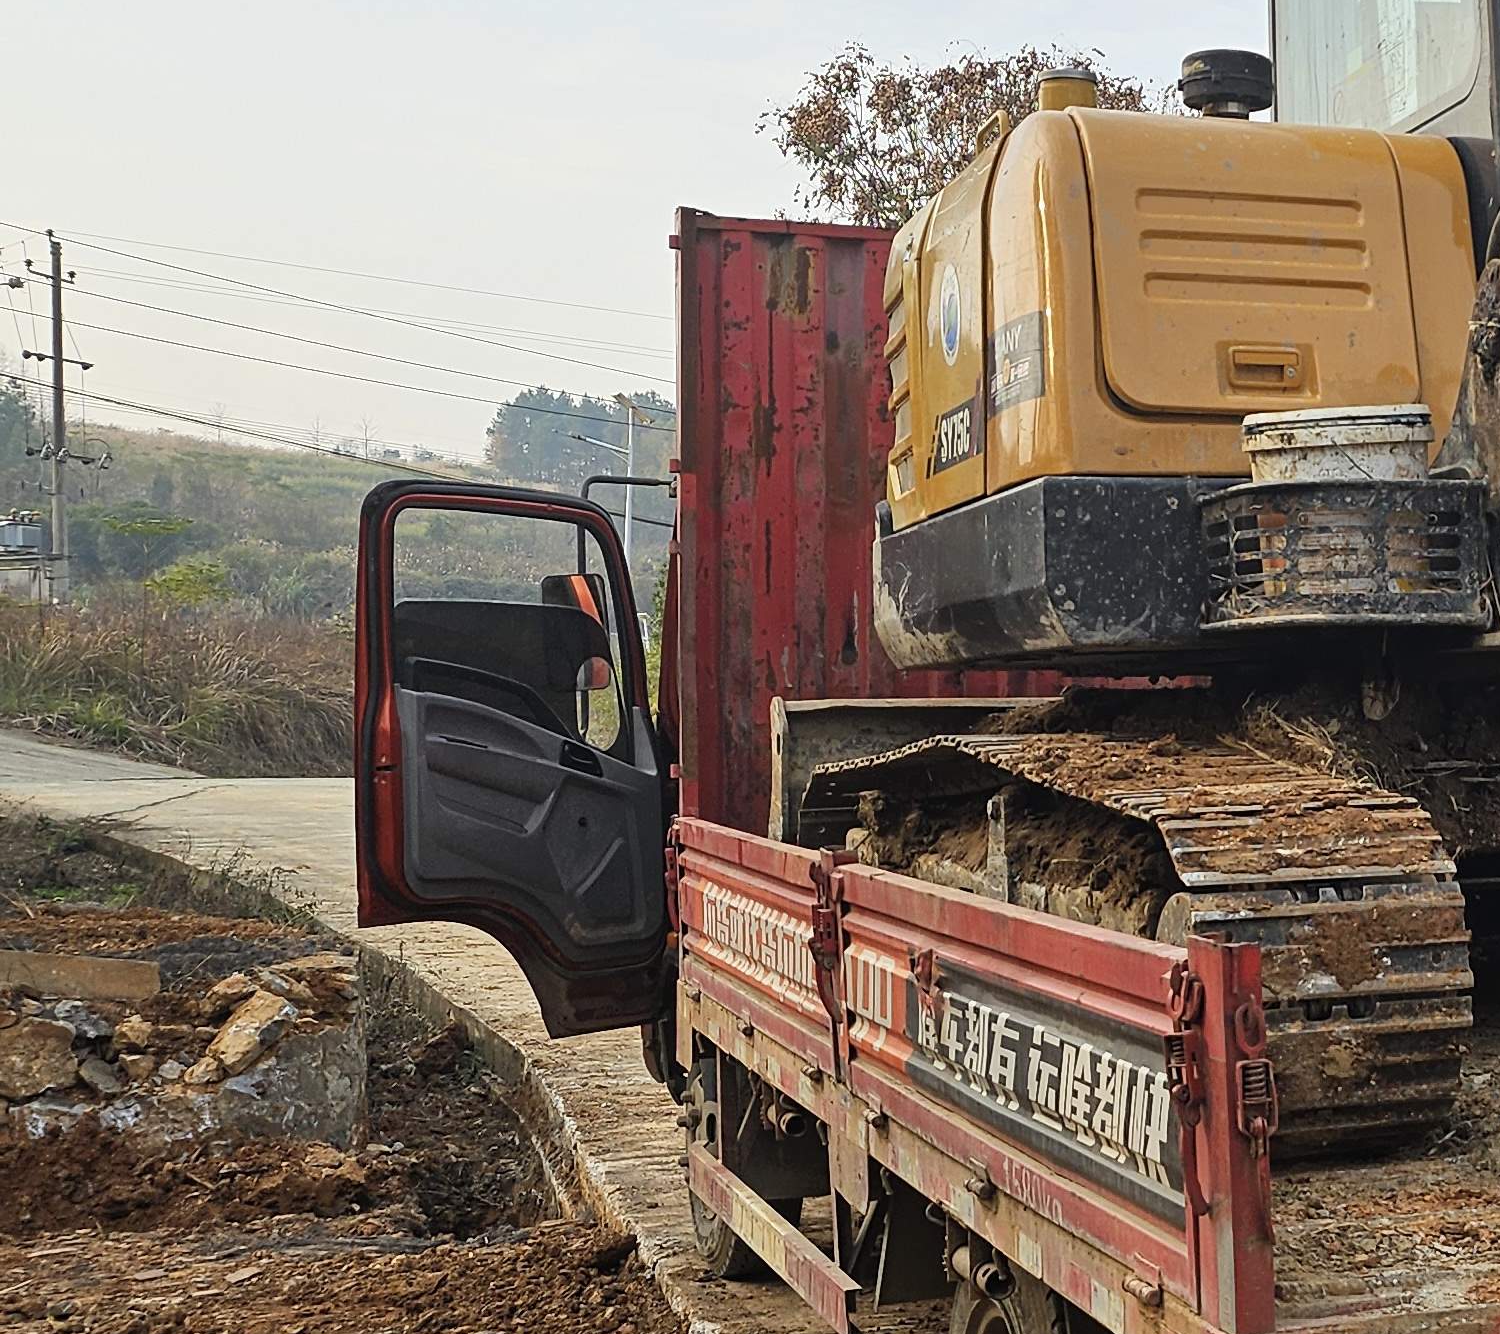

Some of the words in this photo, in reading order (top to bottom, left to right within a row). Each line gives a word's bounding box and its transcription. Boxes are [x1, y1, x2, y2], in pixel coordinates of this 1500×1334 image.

[940, 407, 971, 464] SY75C
[1027, 1024, 1171, 1188] 运啥都快
